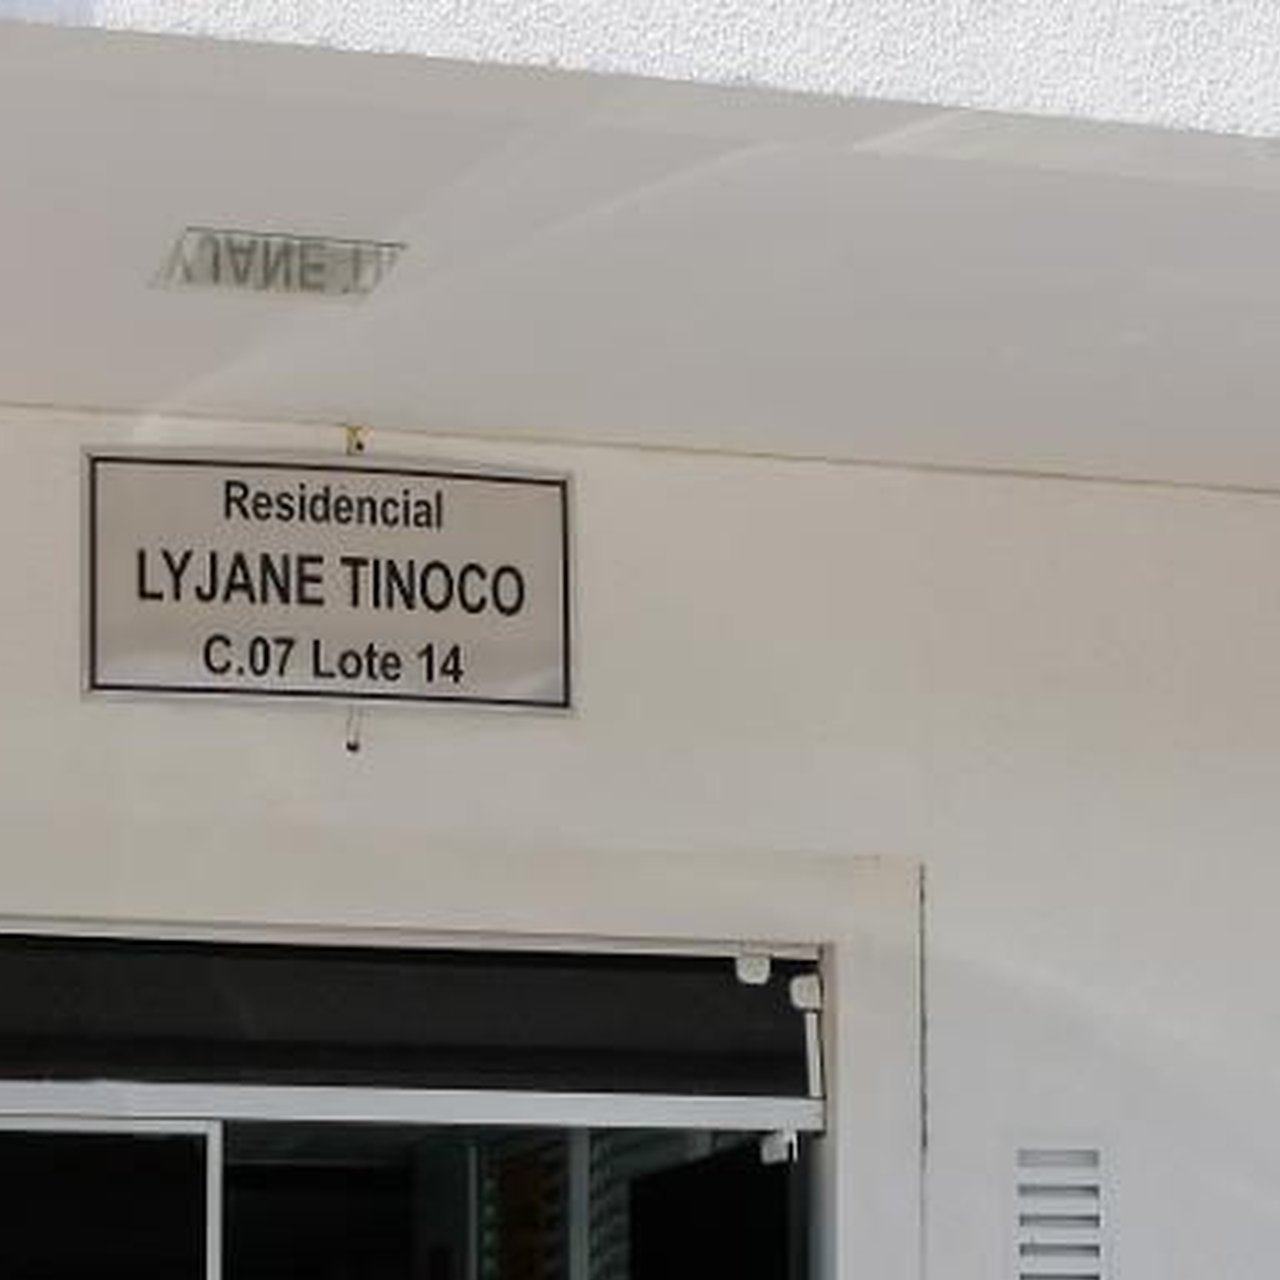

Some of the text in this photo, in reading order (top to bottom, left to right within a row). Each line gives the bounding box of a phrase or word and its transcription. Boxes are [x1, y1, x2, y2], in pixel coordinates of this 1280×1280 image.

[223, 480, 443, 529] Residencial
[137, 549, 526, 616] LYJANE TINOCO
[203, 634, 465, 683] C.07 Lote 14
